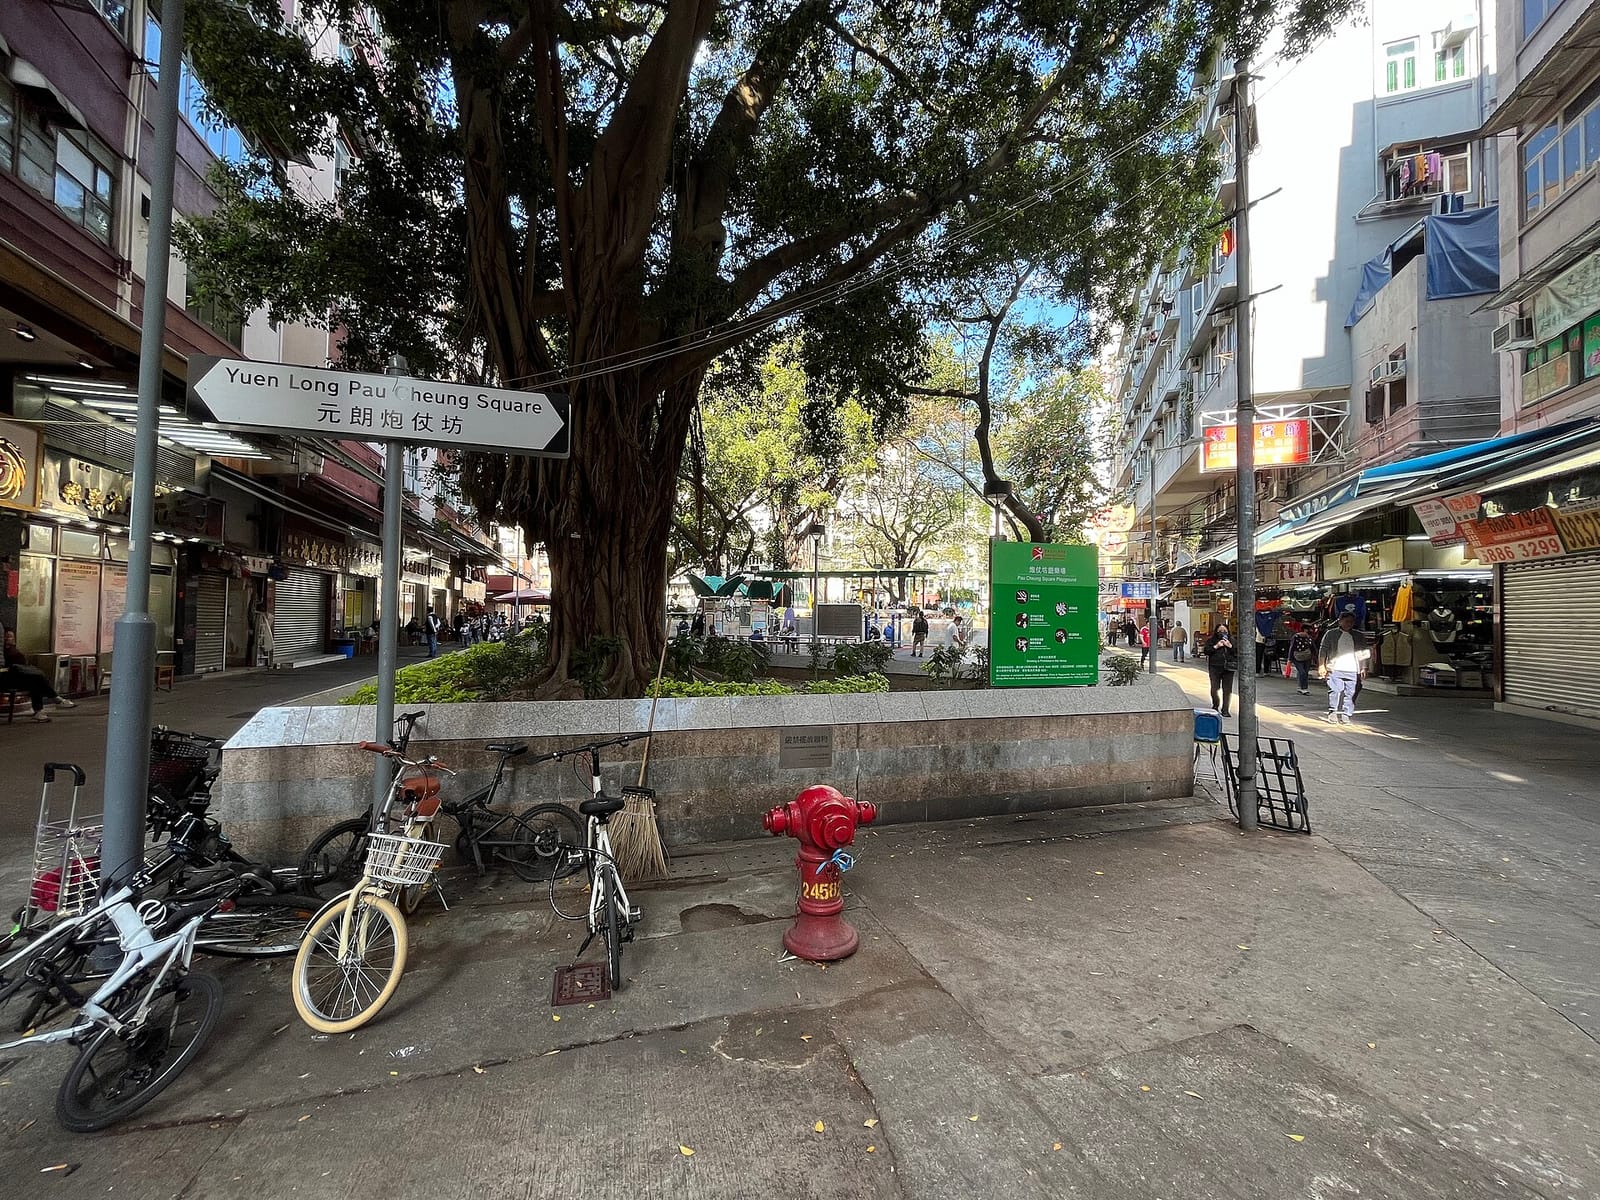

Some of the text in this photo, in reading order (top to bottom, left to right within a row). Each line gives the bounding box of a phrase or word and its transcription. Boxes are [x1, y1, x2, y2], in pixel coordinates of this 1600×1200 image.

[226, 366, 279, 388] Yuen
[289, 373, 339, 397] Long
[349, 381, 386, 399] Pau
[477, 393, 543, 415] Square
[317, 402, 464, 435] 元朗炮仗坊
[1518, 538, 1560, 558] 3299
